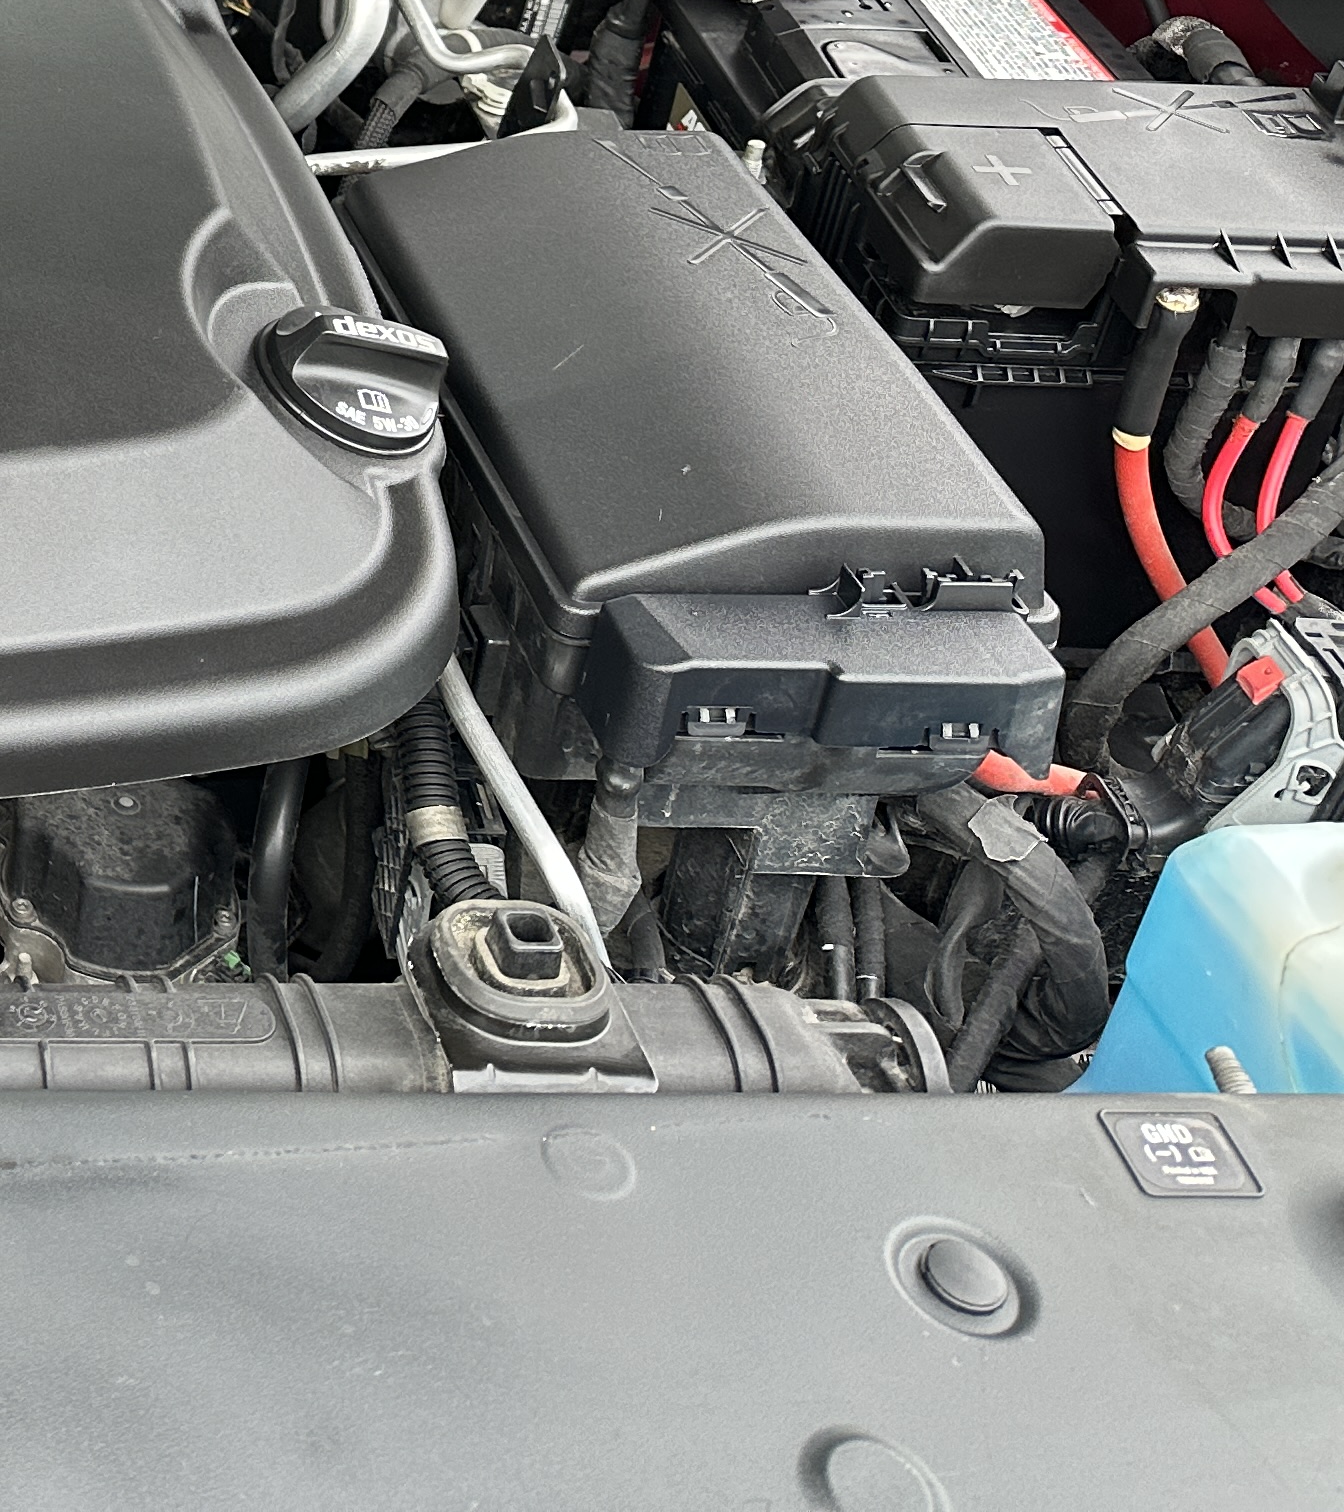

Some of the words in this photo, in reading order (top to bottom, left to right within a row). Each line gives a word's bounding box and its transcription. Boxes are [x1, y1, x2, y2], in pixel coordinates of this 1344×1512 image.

[331, 315, 438, 354] dexos
[335, 401, 367, 426] SAE
[372, 414, 421, 433] 5W-30
[1140, 1122, 1194, 1144] GND
